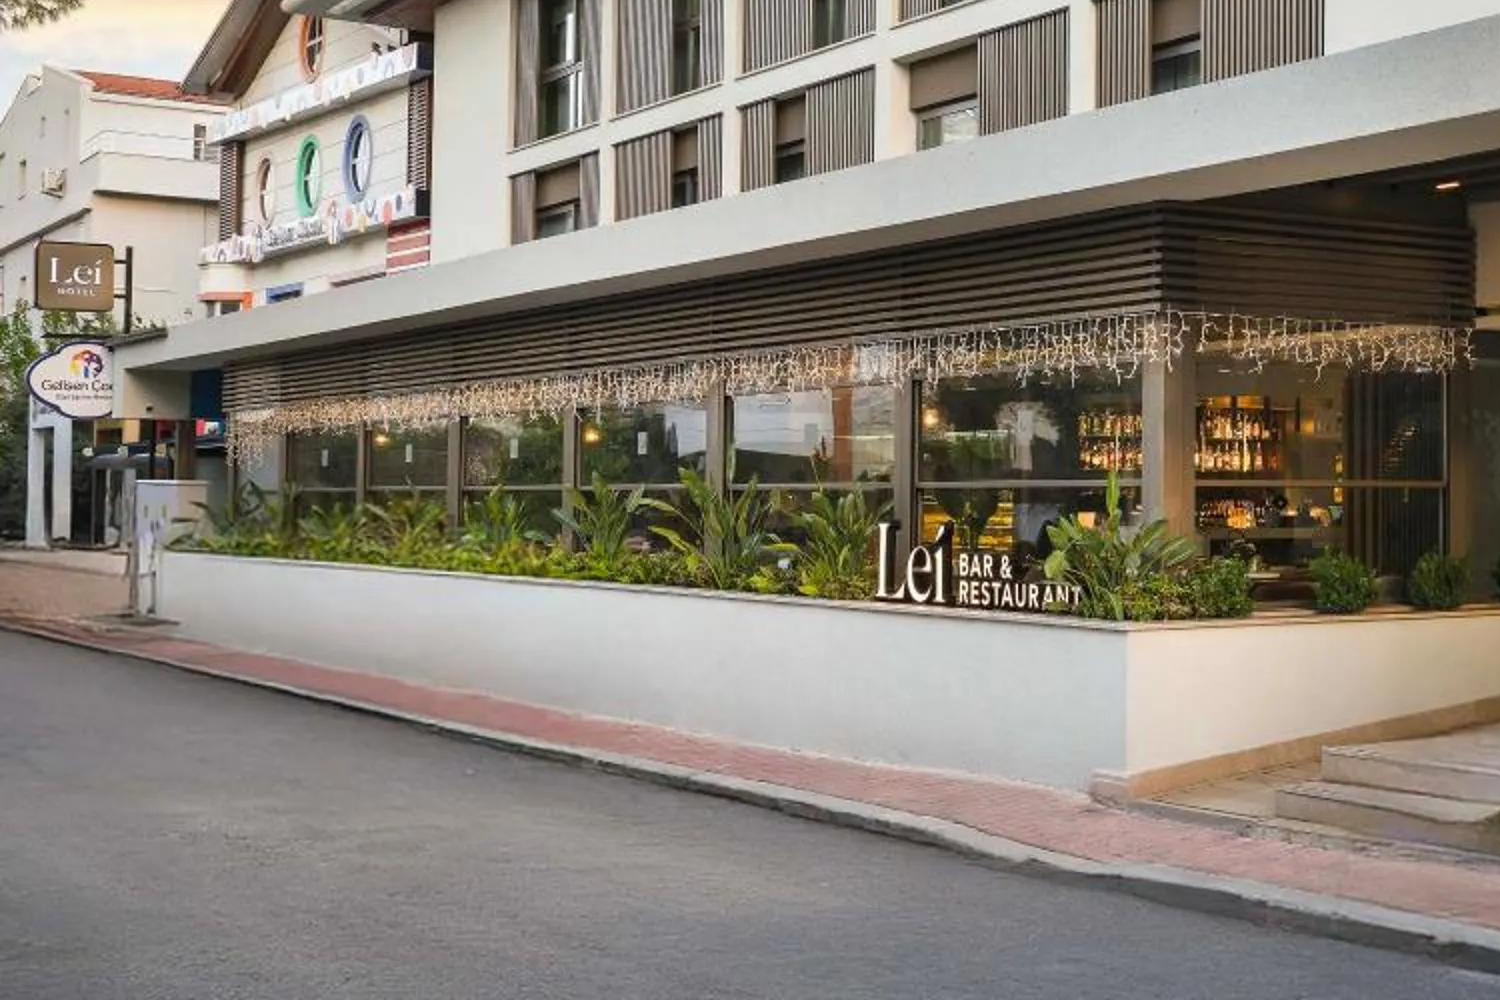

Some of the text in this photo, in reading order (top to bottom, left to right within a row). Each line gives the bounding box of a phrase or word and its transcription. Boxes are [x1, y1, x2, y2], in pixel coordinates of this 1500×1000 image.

[56, 286, 98, 297] HOTEL
[958, 553, 1013, 580] BAR &
[958, 580, 1081, 609] RESTAURANT
